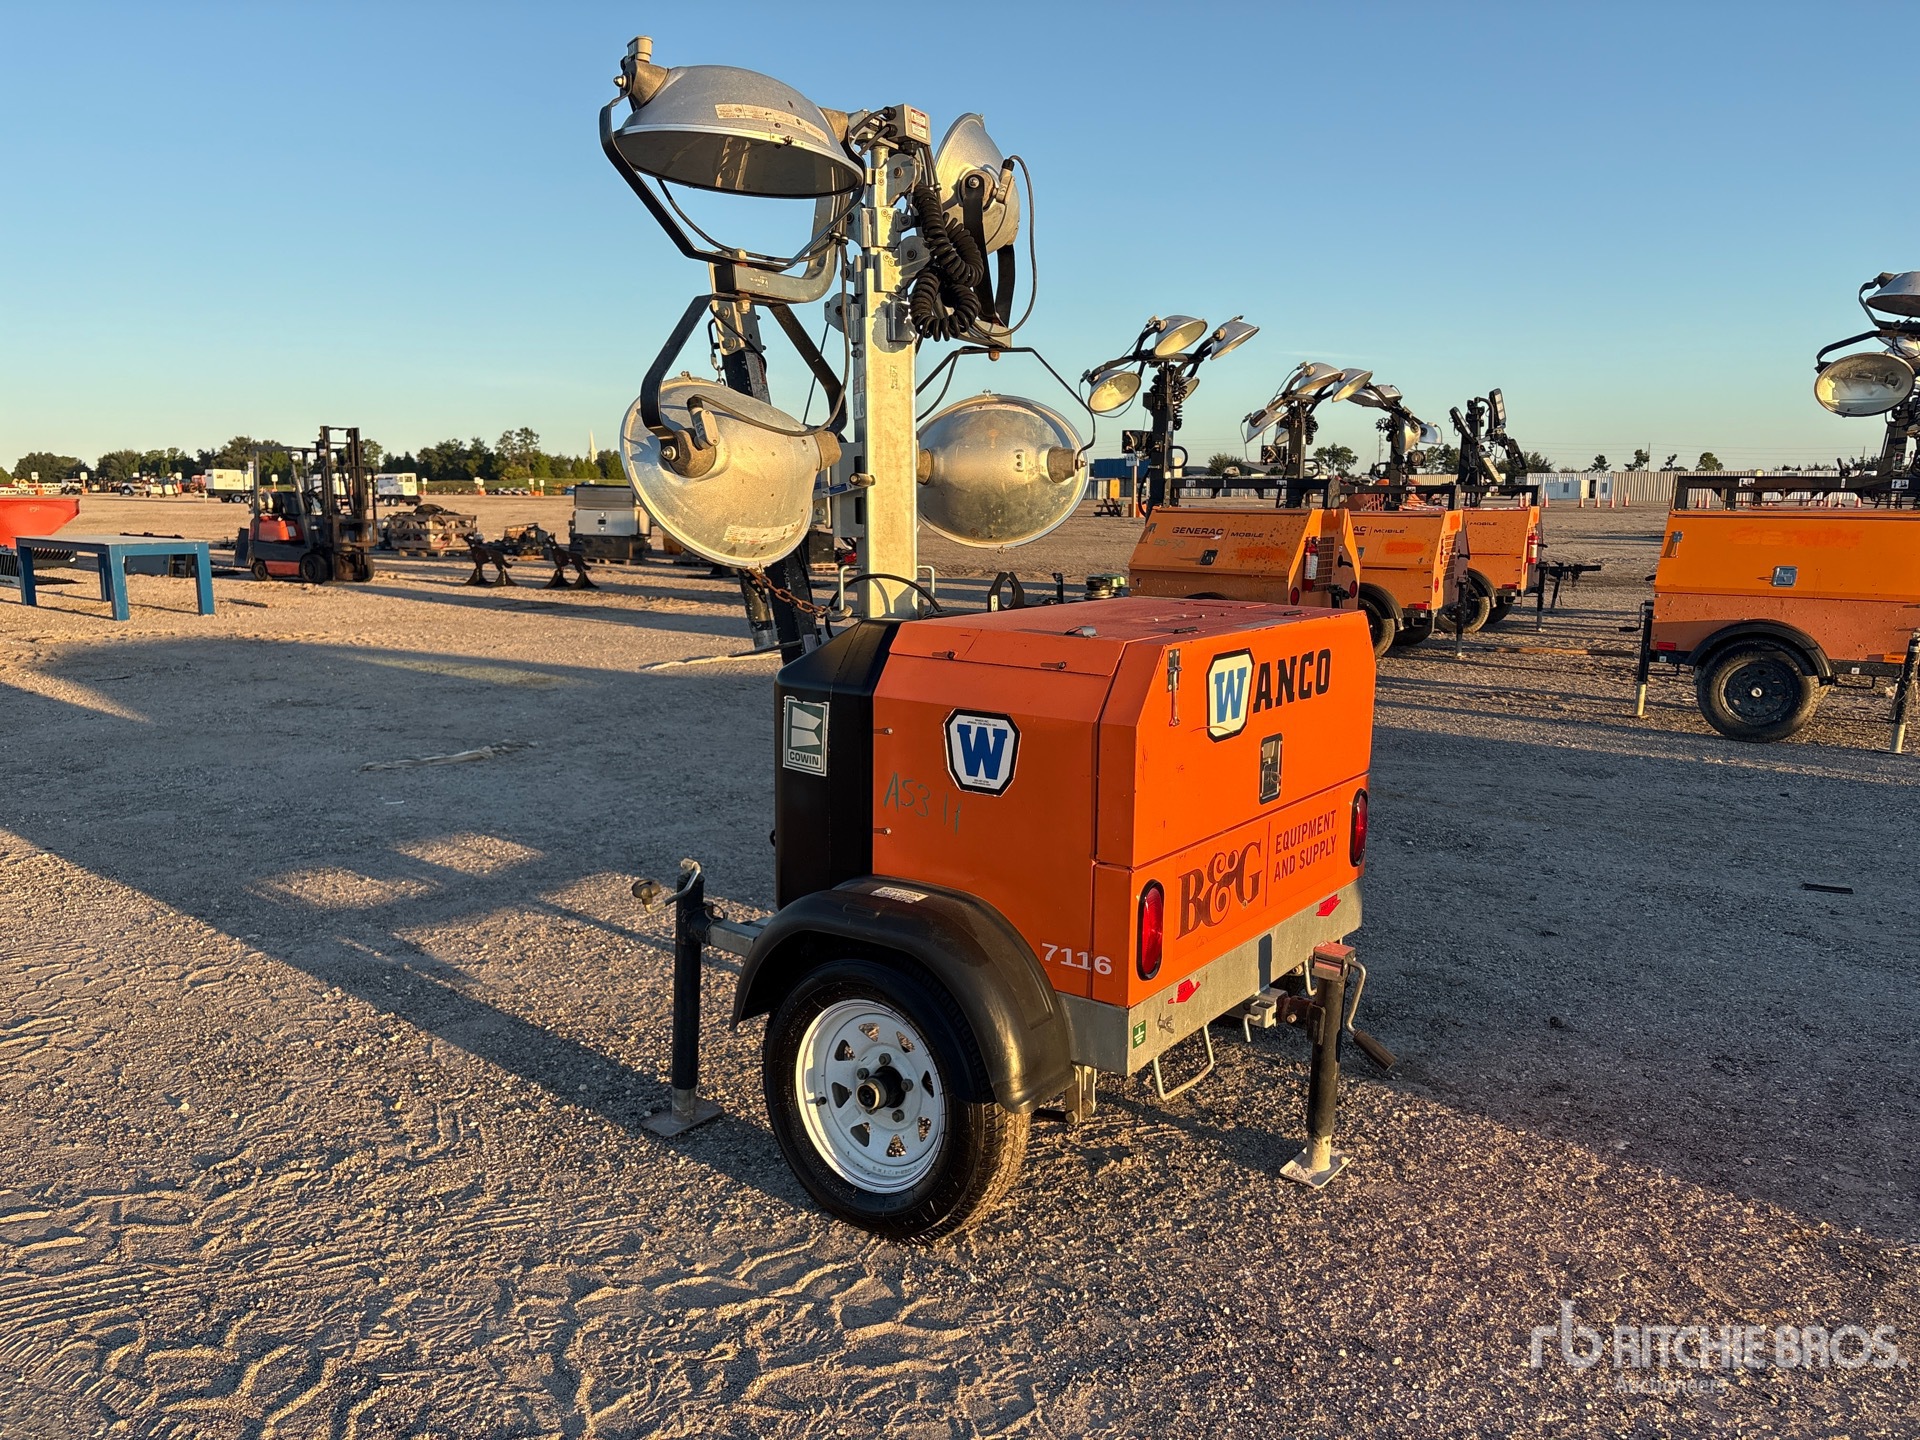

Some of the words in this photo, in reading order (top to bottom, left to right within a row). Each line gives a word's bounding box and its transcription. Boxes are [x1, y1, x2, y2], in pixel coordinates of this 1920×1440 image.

[1171, 526, 1225, 536] GENERAC
[1230, 531, 1264, 539] MOBILE
[789, 751, 819, 766] COWIN
[956, 723, 1008, 780] W
[1175, 838, 1262, 941] B&G
[1275, 809, 1337, 855] EQUIPMENT
[1273, 854, 1296, 883] AND
[1299, 834, 1337, 870] SUPPLY
[1041, 942, 1113, 975] 7116
